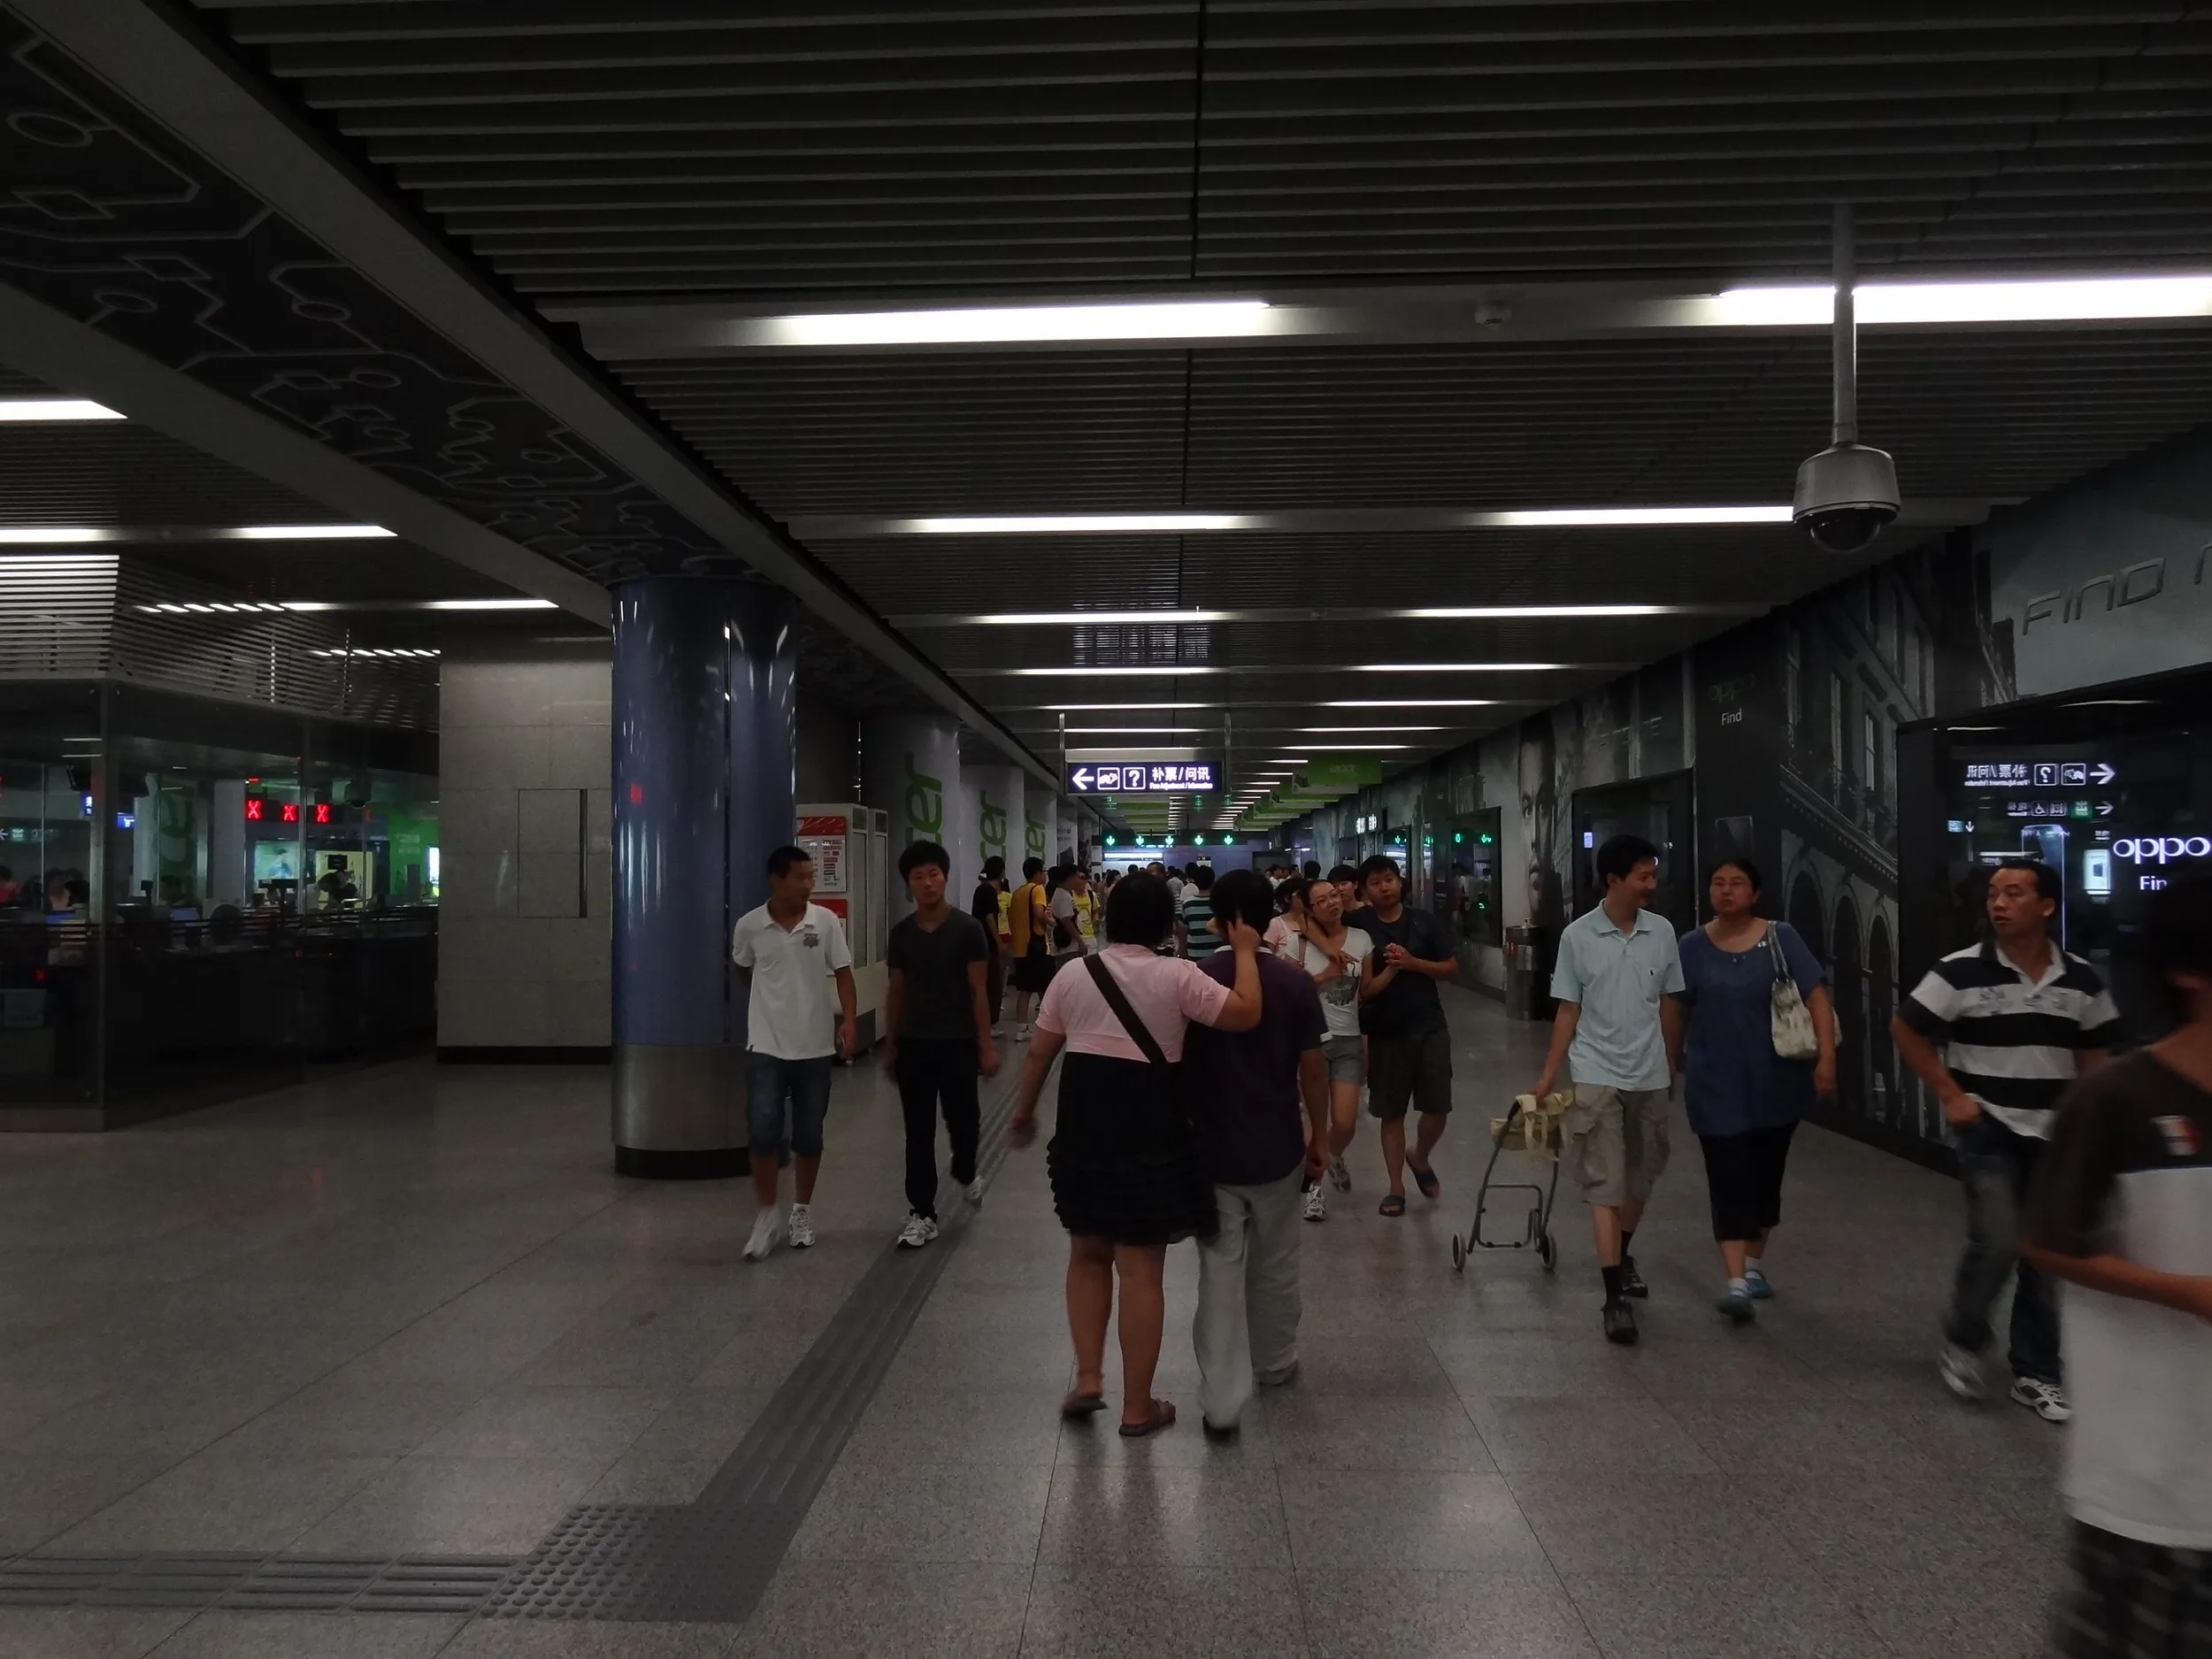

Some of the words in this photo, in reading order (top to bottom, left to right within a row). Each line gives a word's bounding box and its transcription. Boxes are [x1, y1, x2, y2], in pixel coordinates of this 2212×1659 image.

[2023, 557, 2165, 635] FIND
[1721, 707, 1742, 726] Find
[1151, 766, 1210, 781] 补票/问讯
[2112, 836, 2211, 864] oppo
[2139, 875, 2168, 891] Fin
